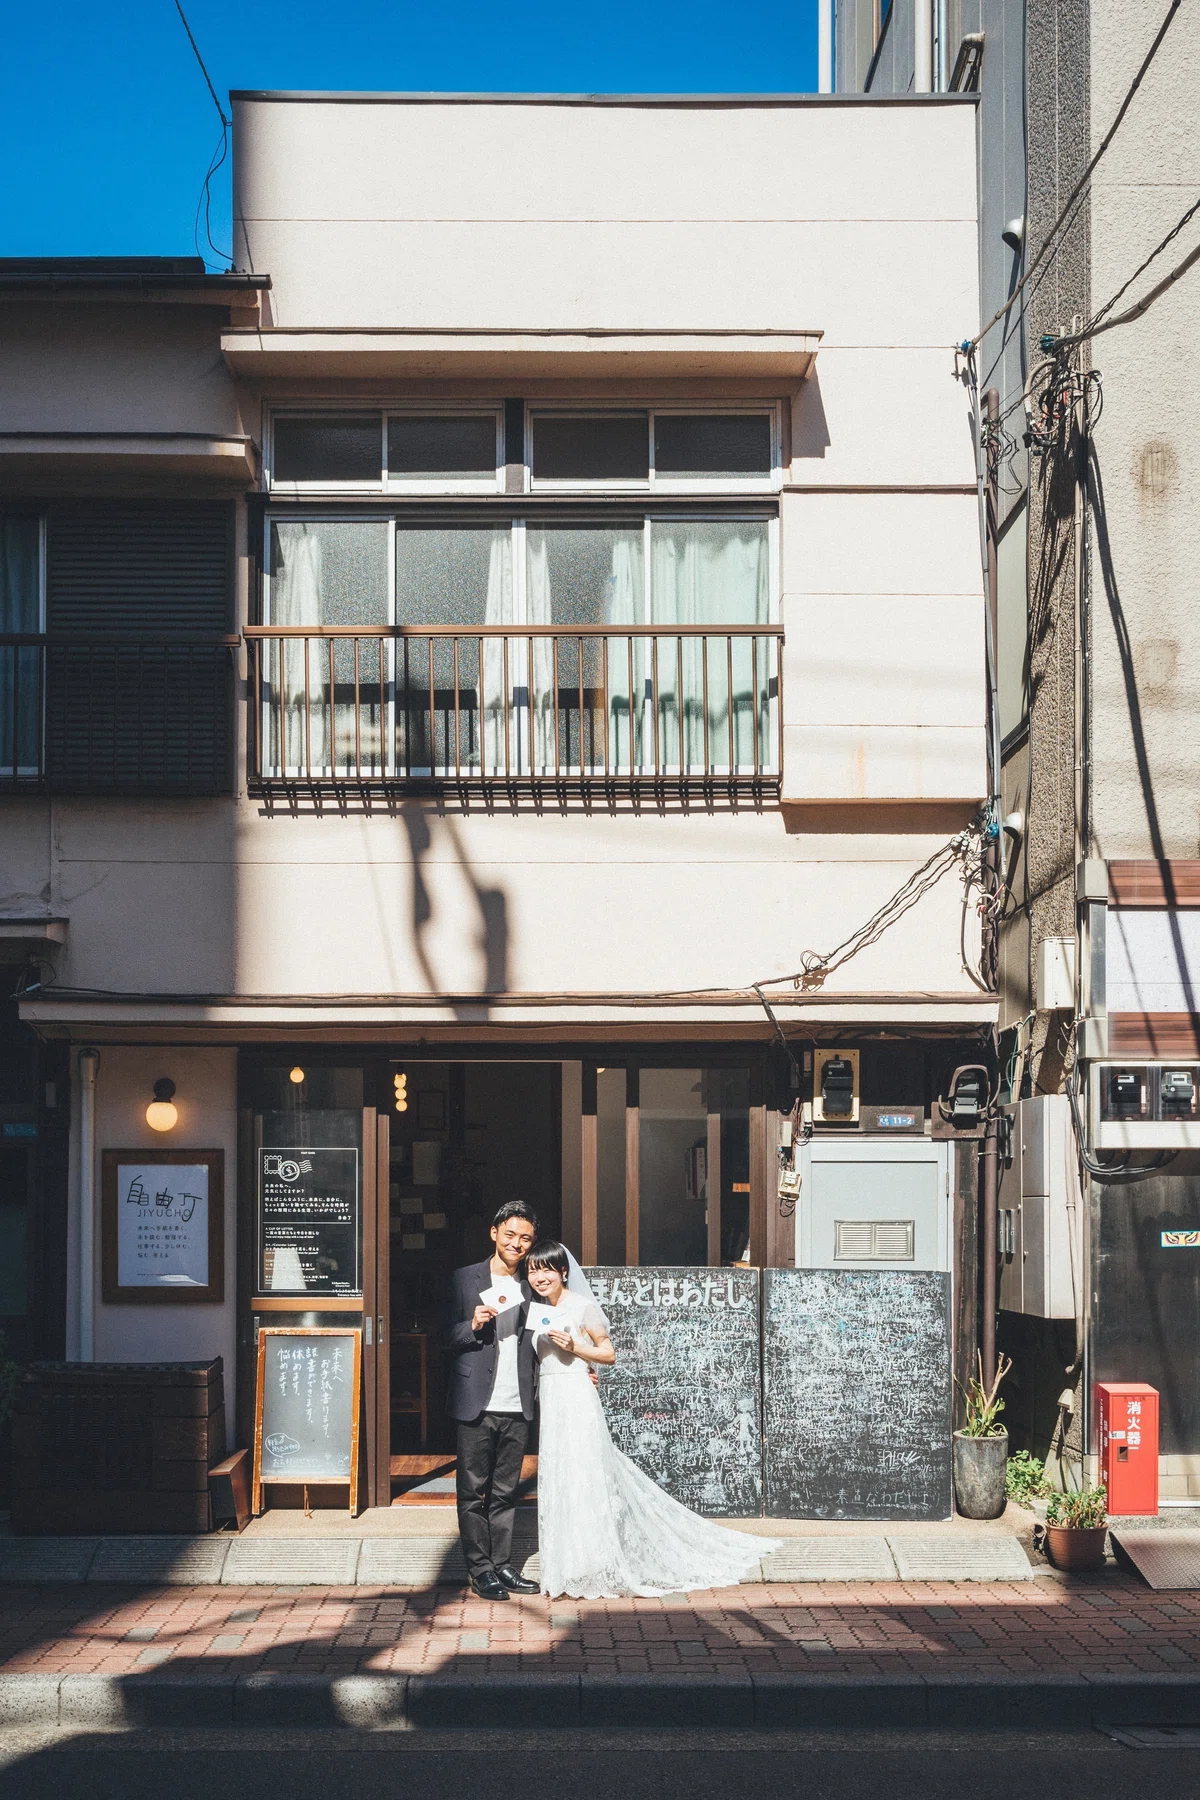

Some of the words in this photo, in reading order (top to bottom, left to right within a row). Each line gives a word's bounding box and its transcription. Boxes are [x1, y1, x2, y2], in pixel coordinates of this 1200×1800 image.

[893, 1116, 912, 1125] 11-2
[127, 1174, 203, 1222] 自由丁
[137, 1208, 192, 1218] JIYUCHO
[331, 1347, 344, 1382] 未来へ
[1126, 1401, 1141, 1445] 消火器
